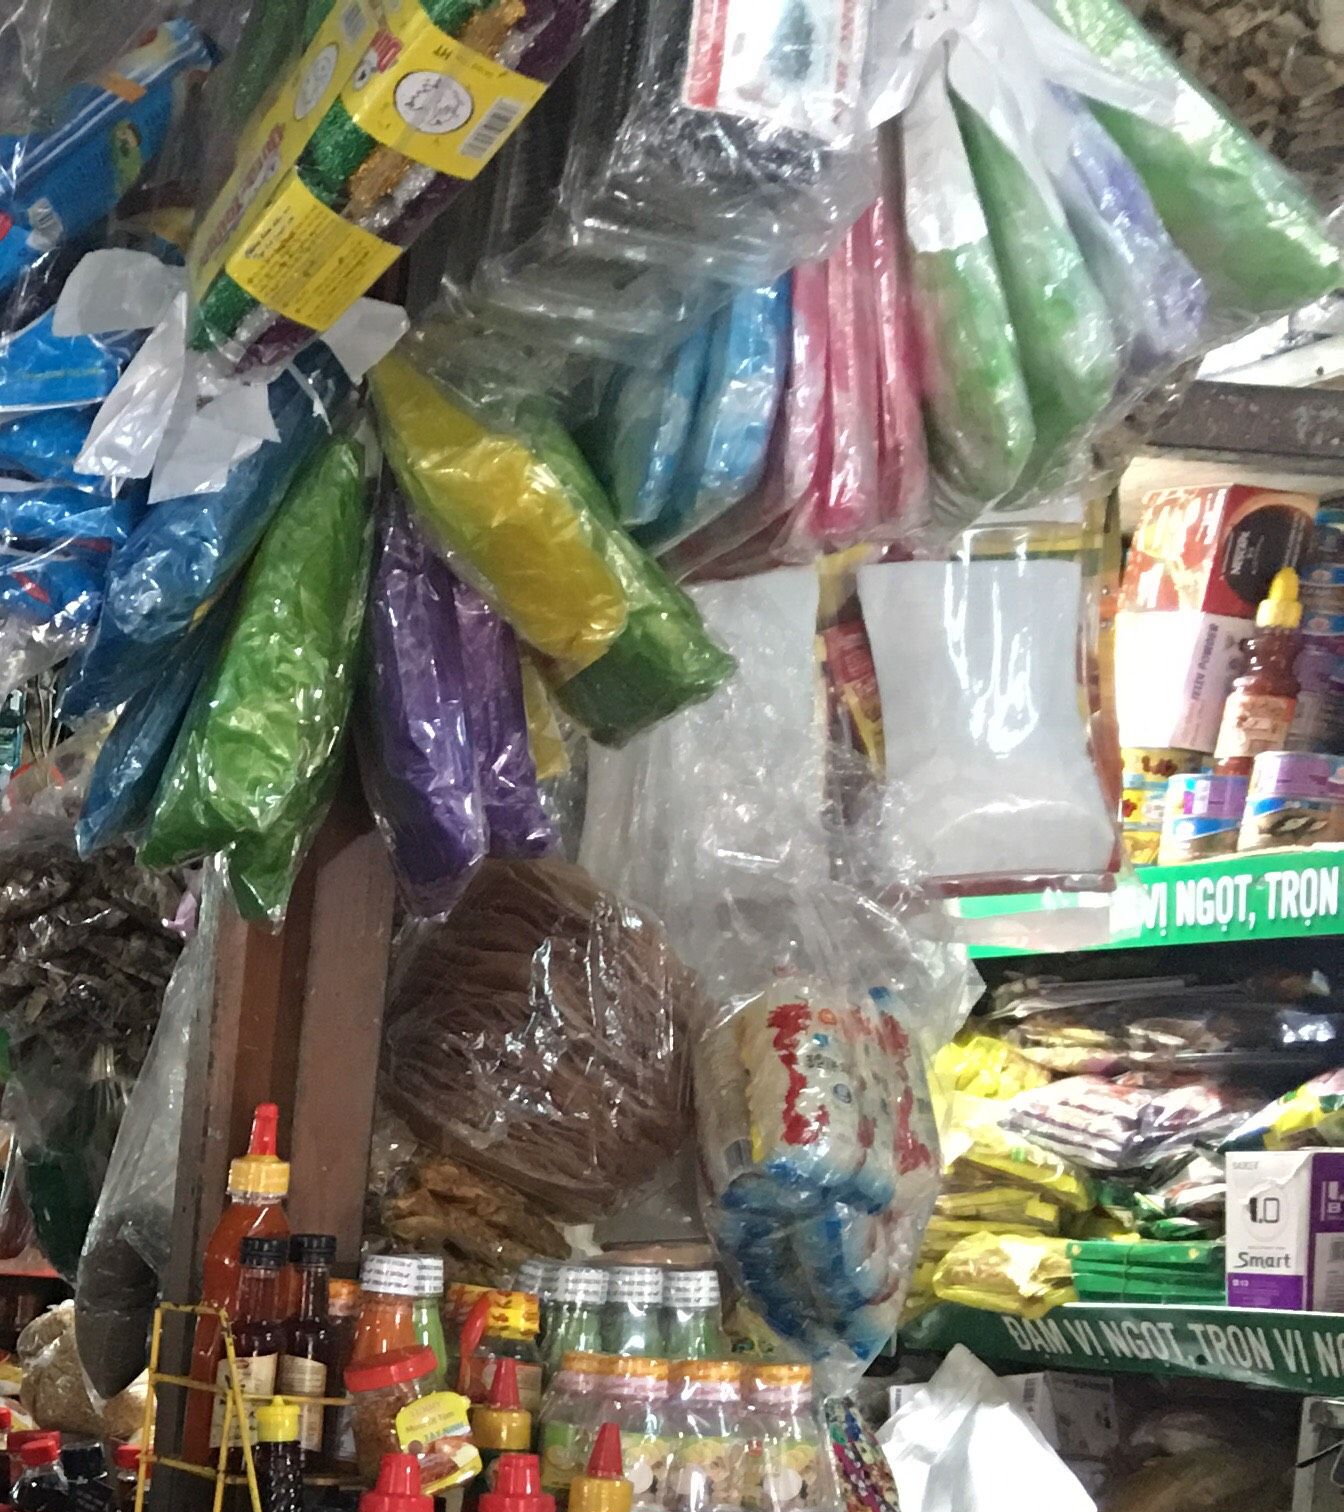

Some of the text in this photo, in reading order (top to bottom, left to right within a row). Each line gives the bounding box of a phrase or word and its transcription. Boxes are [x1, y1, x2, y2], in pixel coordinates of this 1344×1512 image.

[1175, 873, 1256, 931] NGỌT,
[1265, 866, 1339, 927] TRỌN
[1234, 1251, 1293, 1269] Smart
[1062, 1317, 1109, 1364] VỊ
[1274, 1328, 1313, 1383] VỊ
